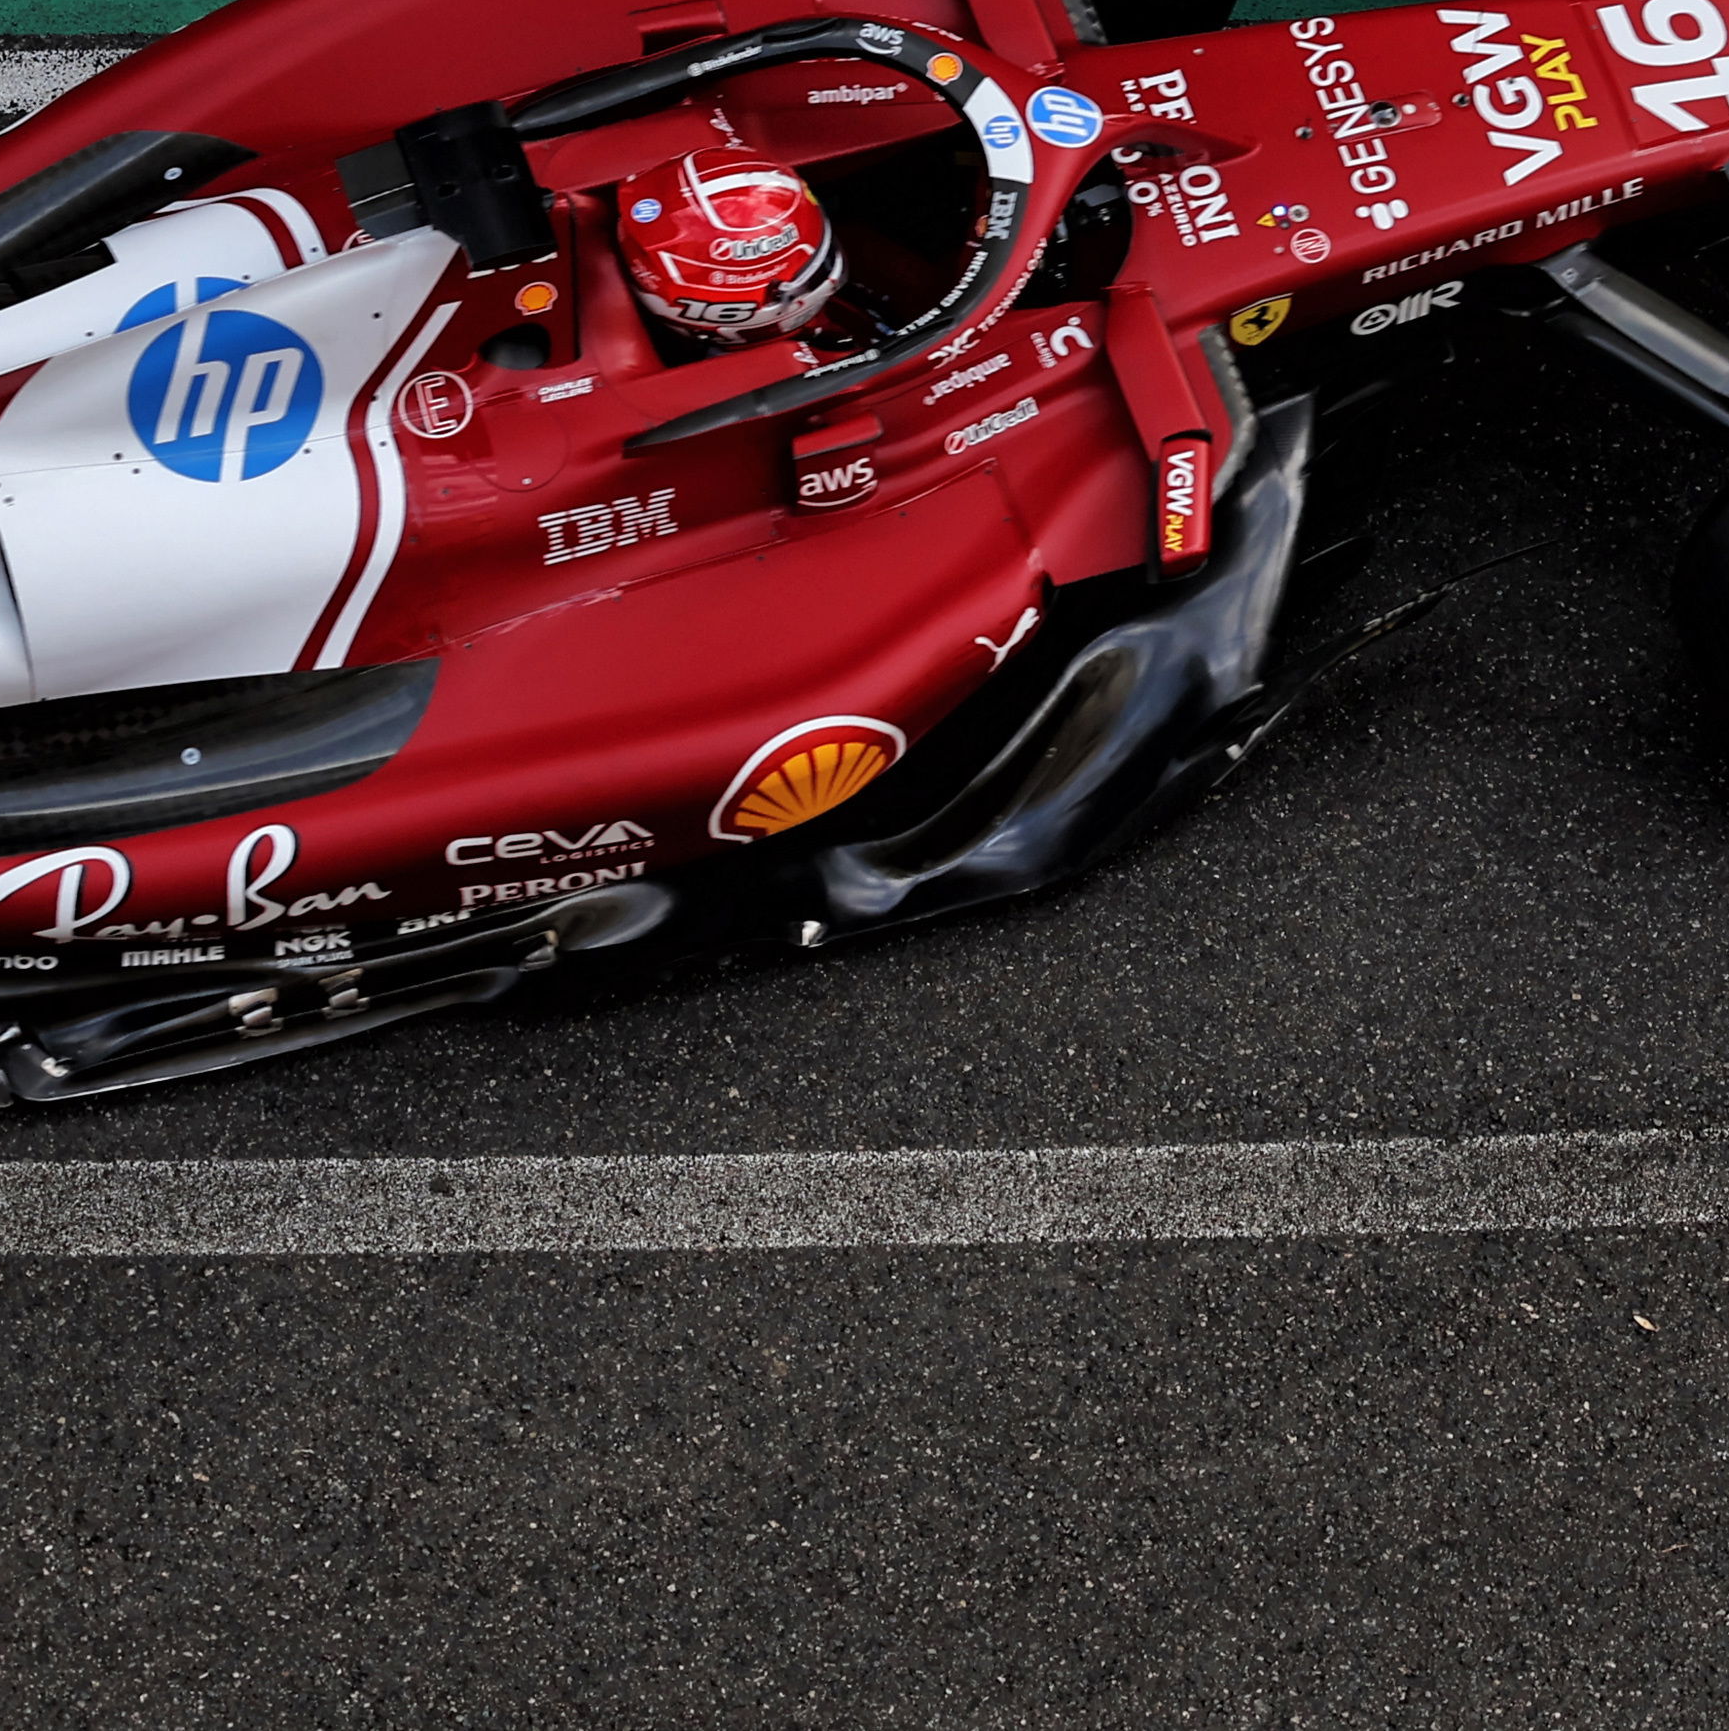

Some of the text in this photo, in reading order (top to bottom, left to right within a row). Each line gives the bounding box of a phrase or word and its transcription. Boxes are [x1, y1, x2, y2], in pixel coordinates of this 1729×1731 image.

[858, 22, 906, 45] aws
[1289, 17, 1397, 195] GENESYS
[1436, 9, 1563, 187] VGW
[1520, 33, 1598, 132] PLAY
[983, 115, 1021, 148] hp
[1029, 89, 1102, 144] hp
[1138, 69, 1241, 243] PEONI
[984, 190, 1019, 240] IBM
[1158, 172, 1198, 247] AZZURRO
[1361, 176, 1644, 285] RICHARD MILLE
[732, 223, 800, 260] UniCredit
[677, 298, 759, 324] 16
[153, 310, 305, 482] hp
[799, 458, 876, 497] aws
[1166, 450, 1196, 516] VGW
[537, 488, 678, 565] IBM
[1164, 514, 1185, 552] PLAY
[539, 839, 656, 865] LOGISTICS
[459, 861, 647, 909] PERONI
[121, 945, 226, 968] MAHLE
[274, 930, 352, 957] NGK
